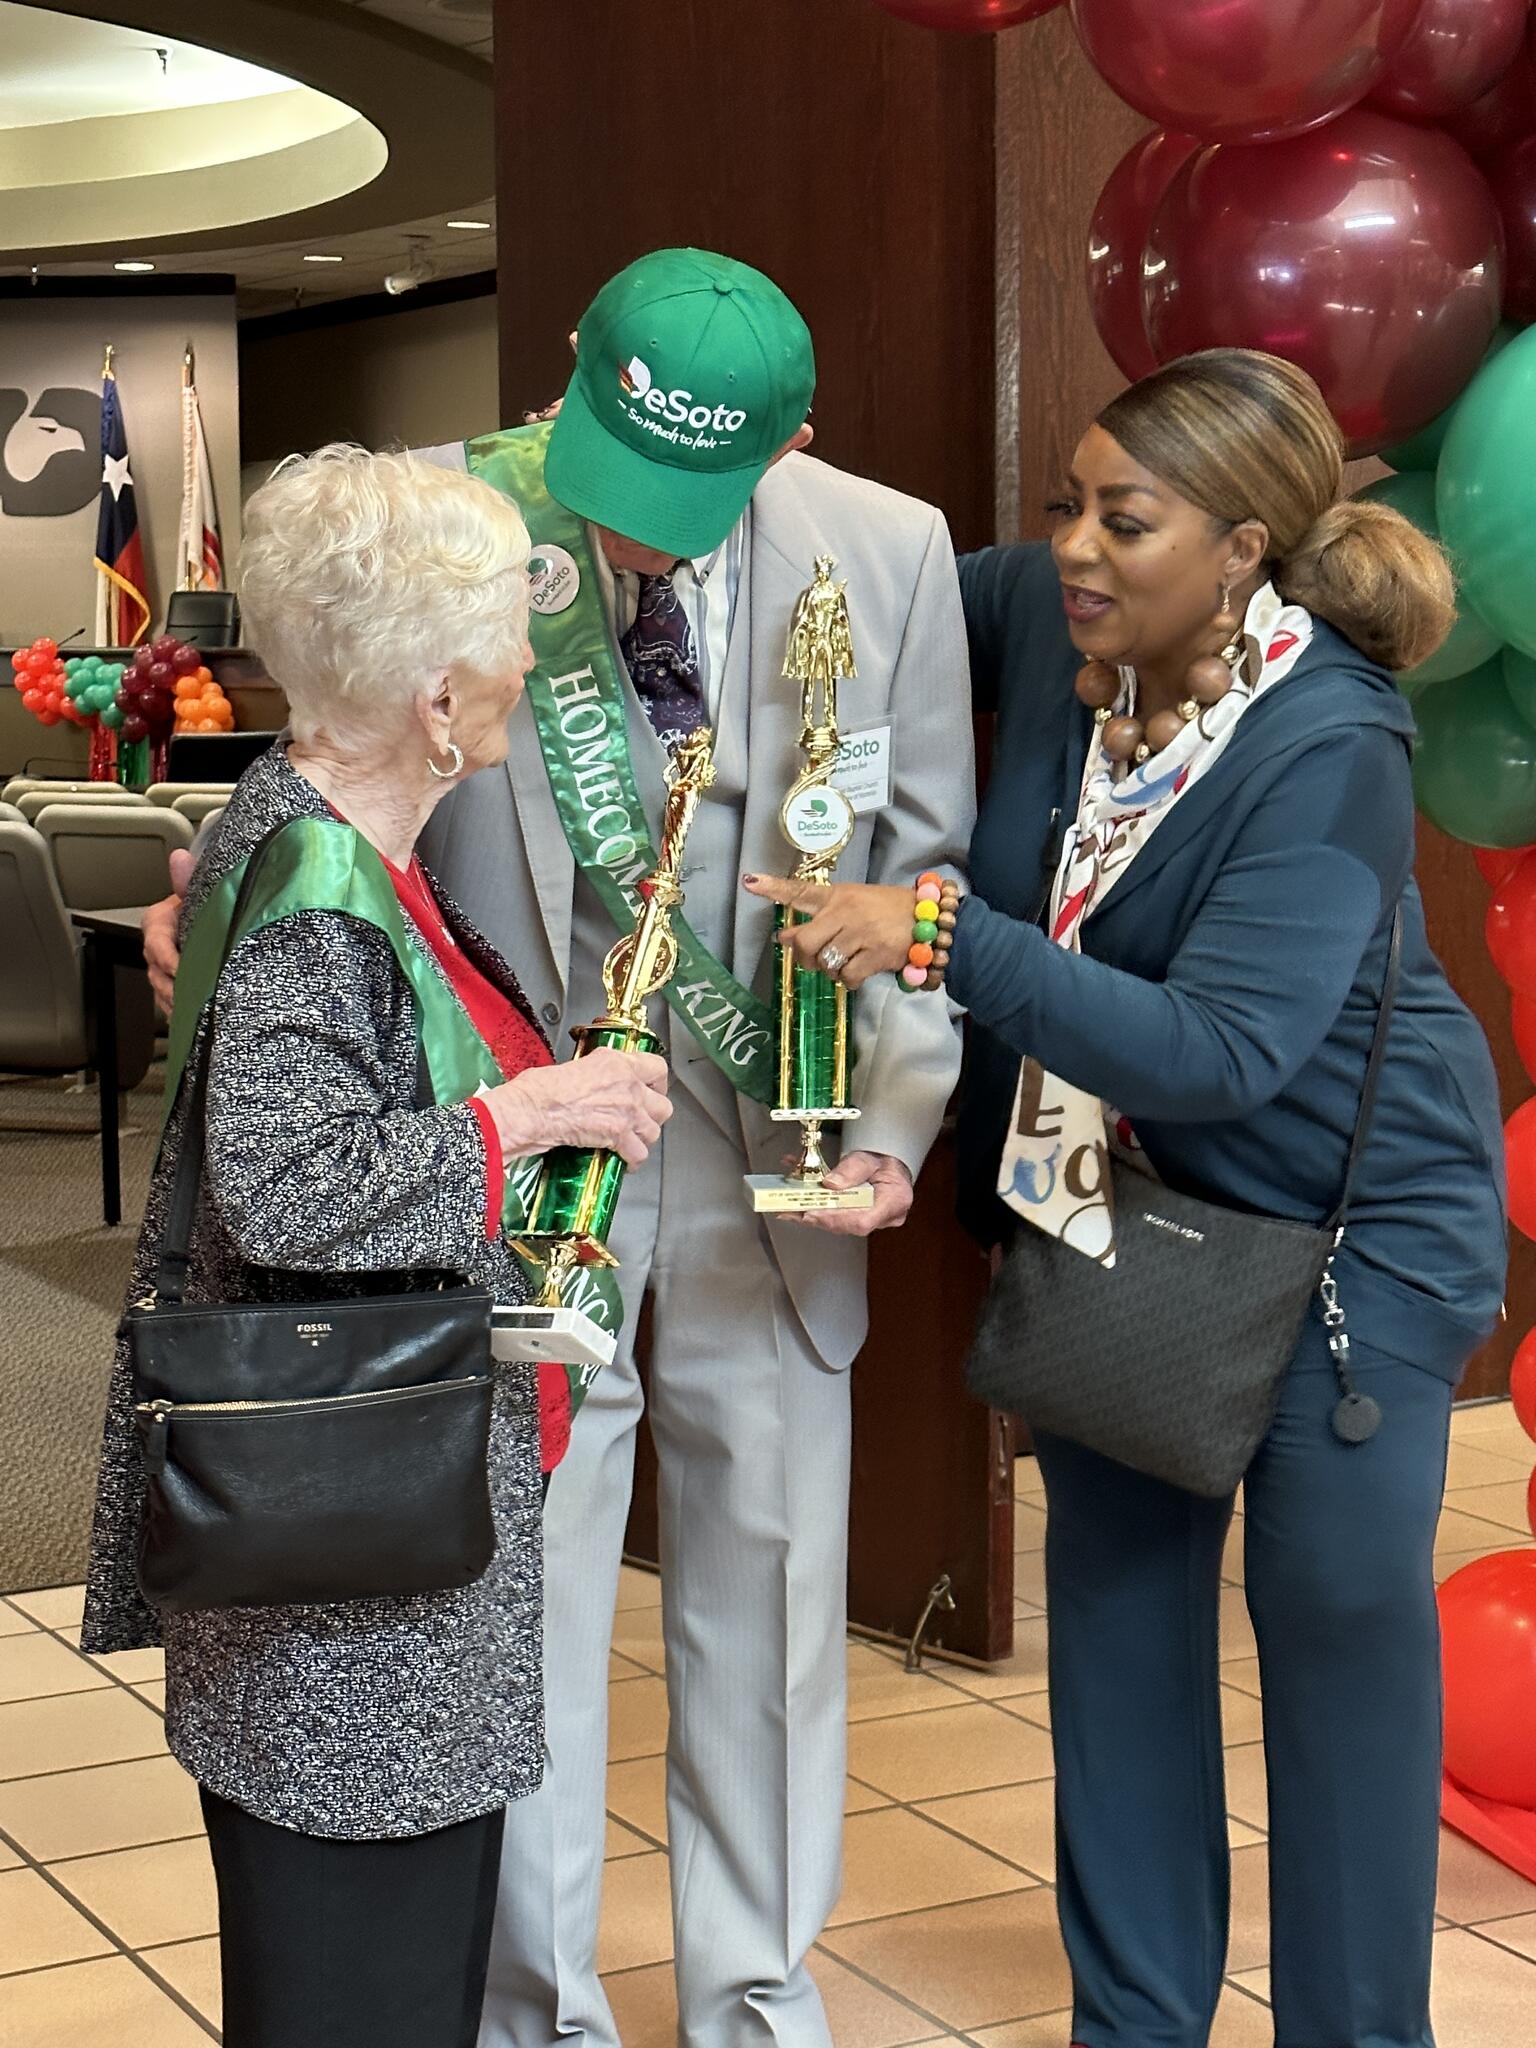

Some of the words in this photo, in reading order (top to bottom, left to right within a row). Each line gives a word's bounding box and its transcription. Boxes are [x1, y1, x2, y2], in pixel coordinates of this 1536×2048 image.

[619, 356, 747, 432] DeSoto
[680, 433, 694, 446] to
[532, 566, 571, 606] DeSoto
[797, 820, 838, 832] DeSoto
[676, 977, 772, 1066] KING
[297, 1323, 333, 1332] FOSSIL
